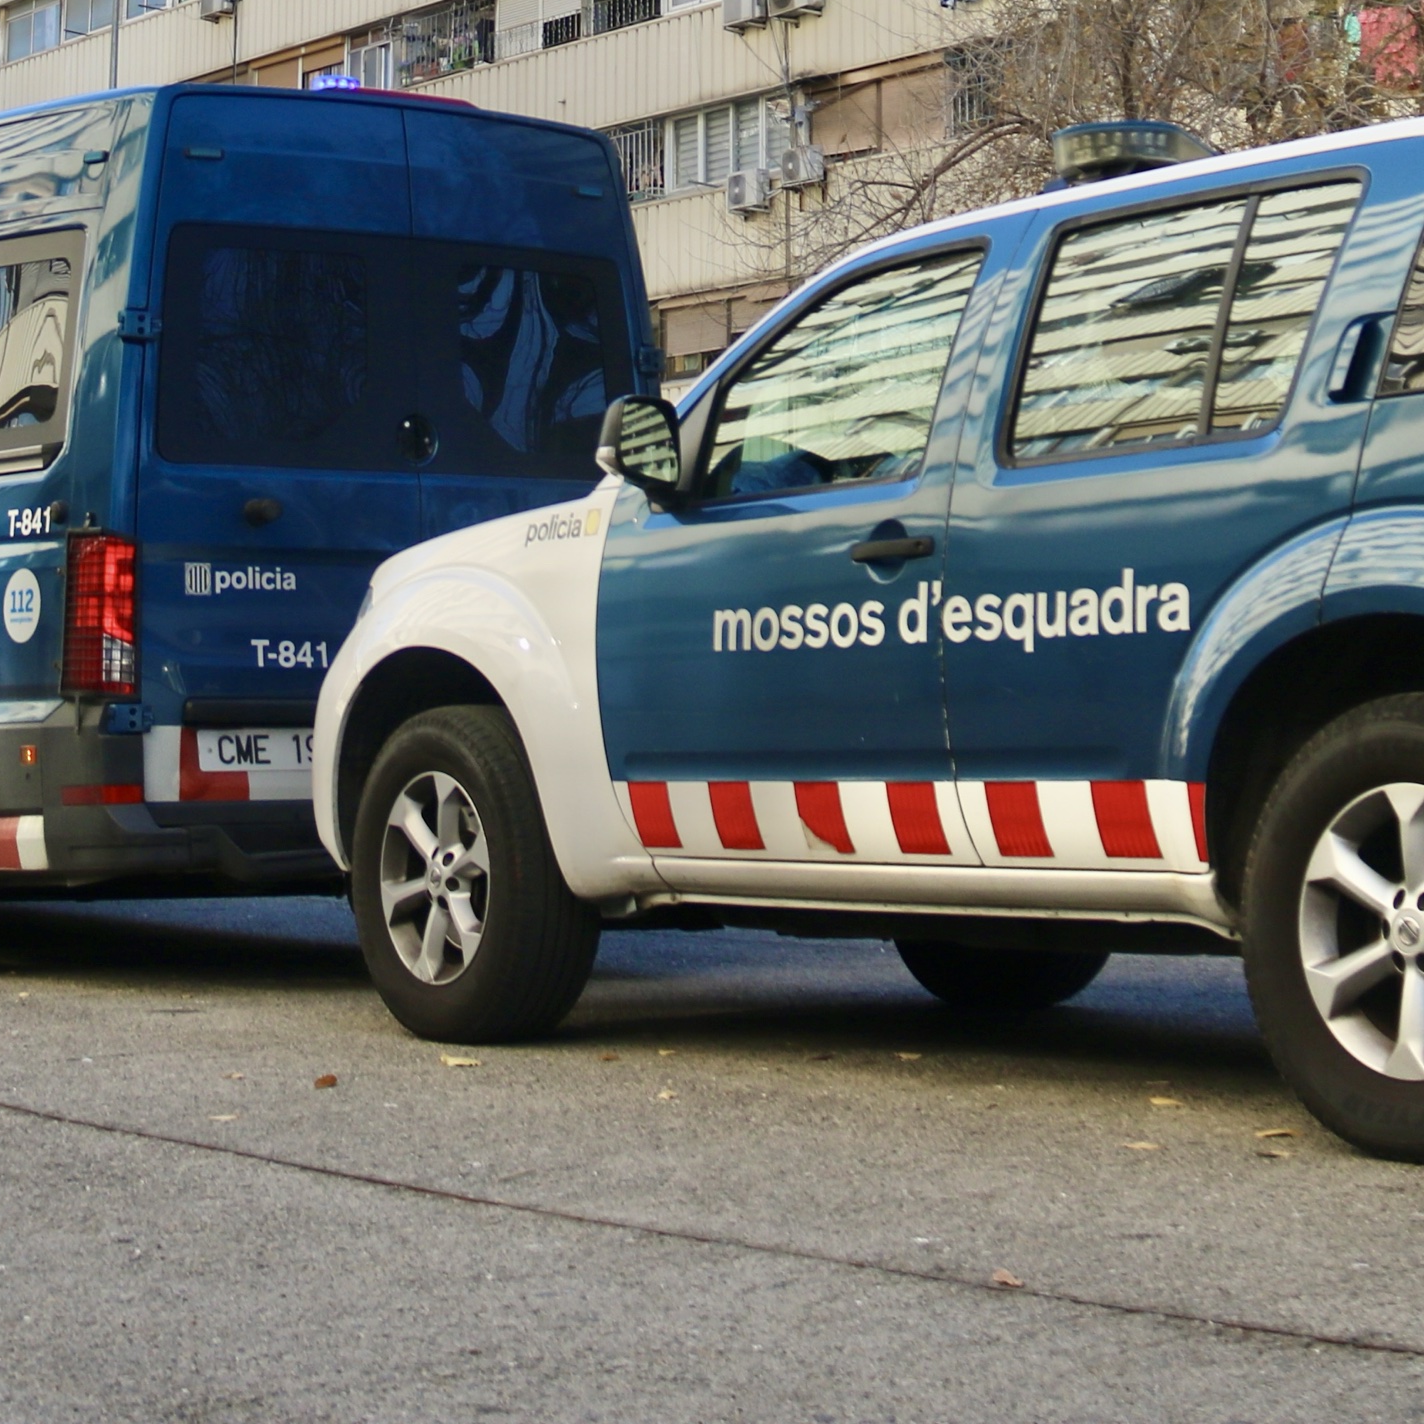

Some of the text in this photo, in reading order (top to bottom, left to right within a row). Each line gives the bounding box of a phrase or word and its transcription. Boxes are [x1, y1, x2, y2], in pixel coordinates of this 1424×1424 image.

[8, 506, 52, 537] T-841
[524, 512, 582, 548] policia
[215, 566, 296, 594] policia
[10, 588, 34, 613] 112
[713, 567, 1191, 653] mossos d'esquadra
[250, 639, 328, 668] T-841
[218, 735, 271, 764] CME
